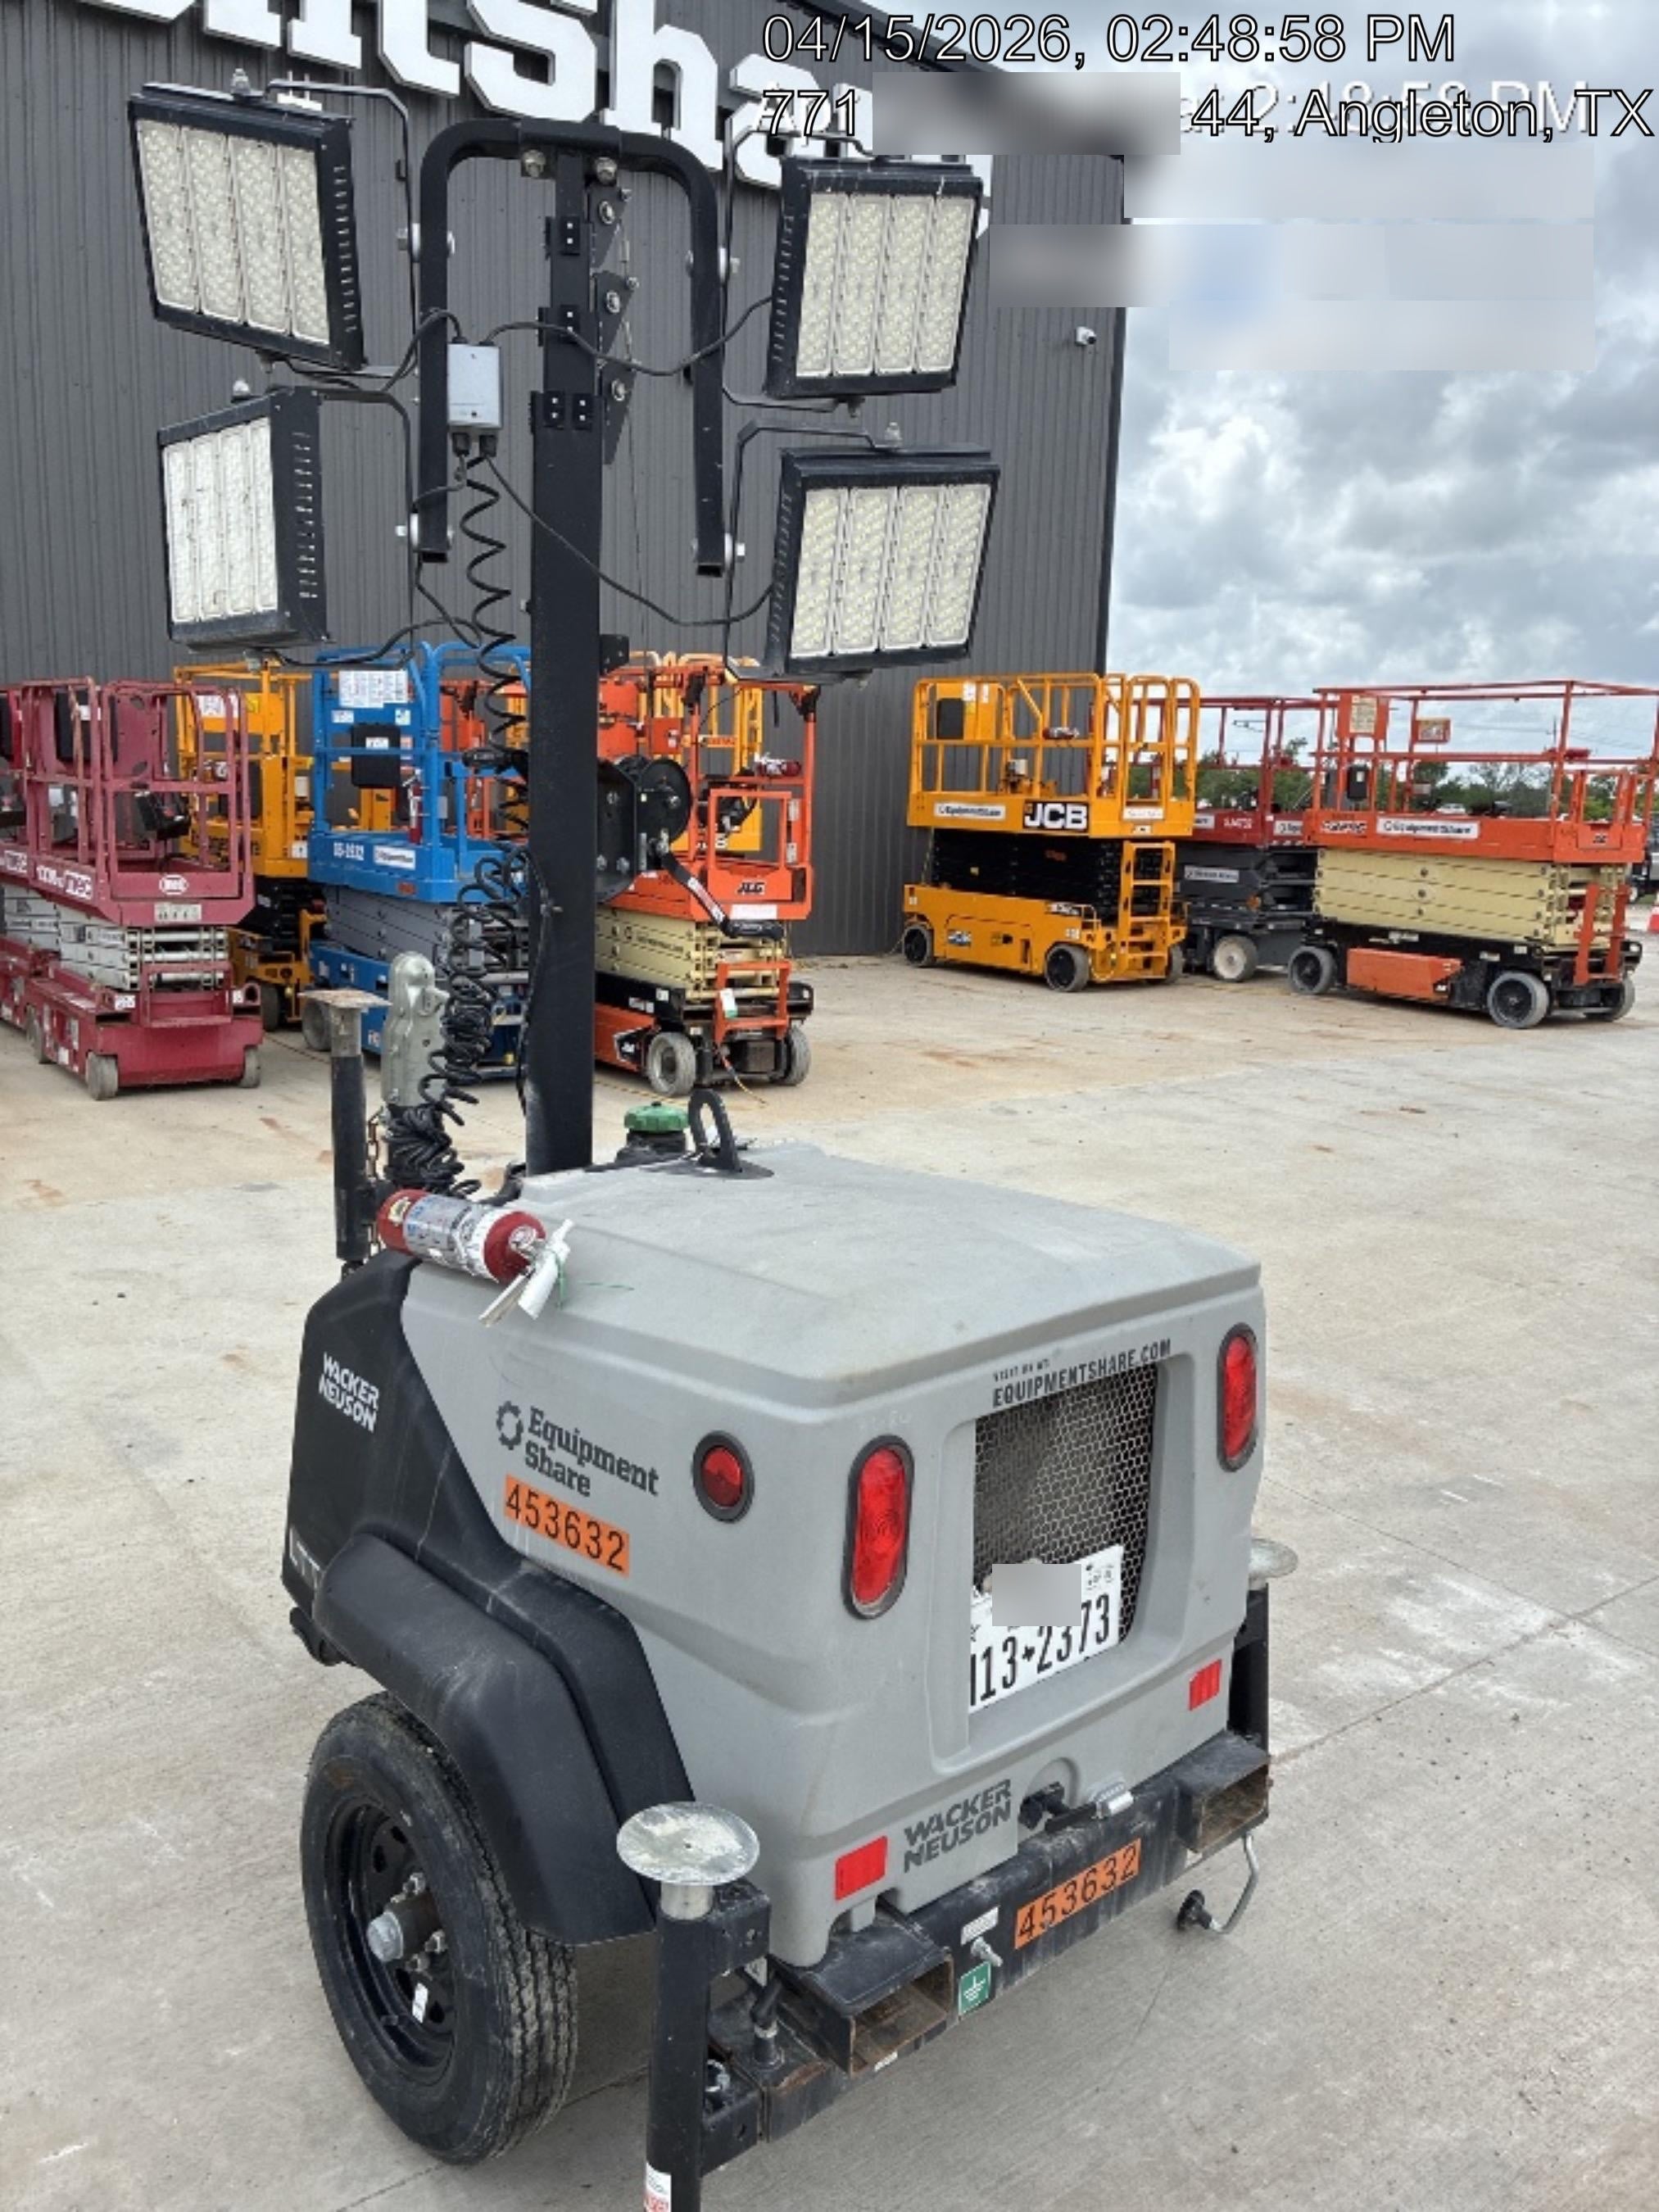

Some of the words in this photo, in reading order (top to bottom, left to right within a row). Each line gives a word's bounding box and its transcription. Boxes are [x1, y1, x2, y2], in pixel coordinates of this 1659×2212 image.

[1025, 802, 1088, 830] JCB
[318, 1372, 378, 1434] NEUSON
[323, 1351, 380, 1412] WACKER
[992, 1338, 1172, 1408] EQUIPMENTSHARE.COM
[524, 1439, 591, 1498] Share
[528, 1405, 660, 1498] Equipment
[505, 1483, 625, 1572] 453632
[904, 1778, 1012, 1847] WACKER
[904, 1798, 1012, 1874] NEUSON
[1017, 1845, 1137, 1941] 453632
